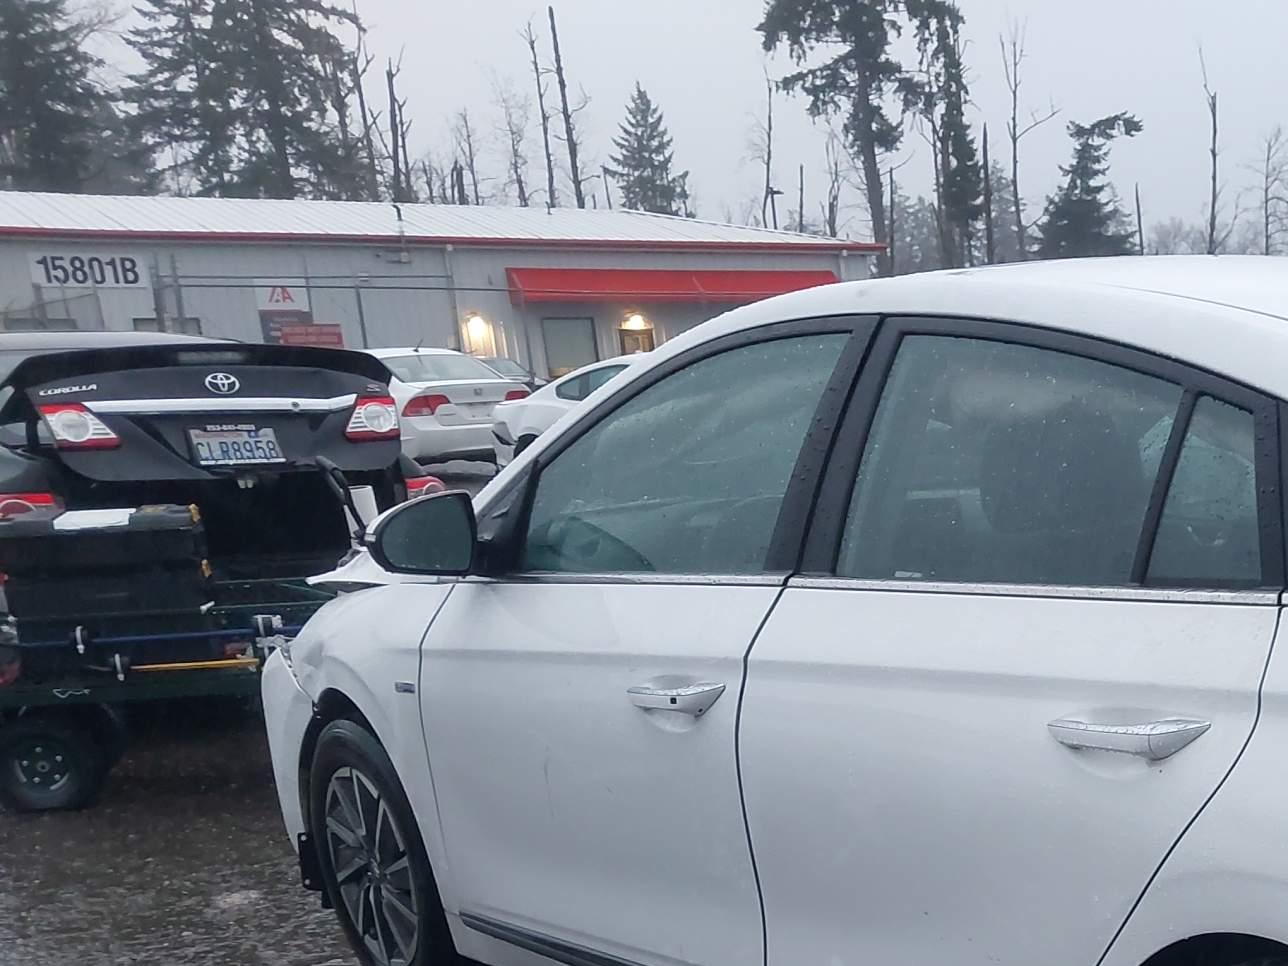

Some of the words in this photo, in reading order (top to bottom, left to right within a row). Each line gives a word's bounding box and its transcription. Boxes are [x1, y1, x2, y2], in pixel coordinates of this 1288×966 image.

[35, 255, 140, 285] 15801B
[39, 383, 97, 396] COROLLA
[195, 439, 279, 460] CLR8958
